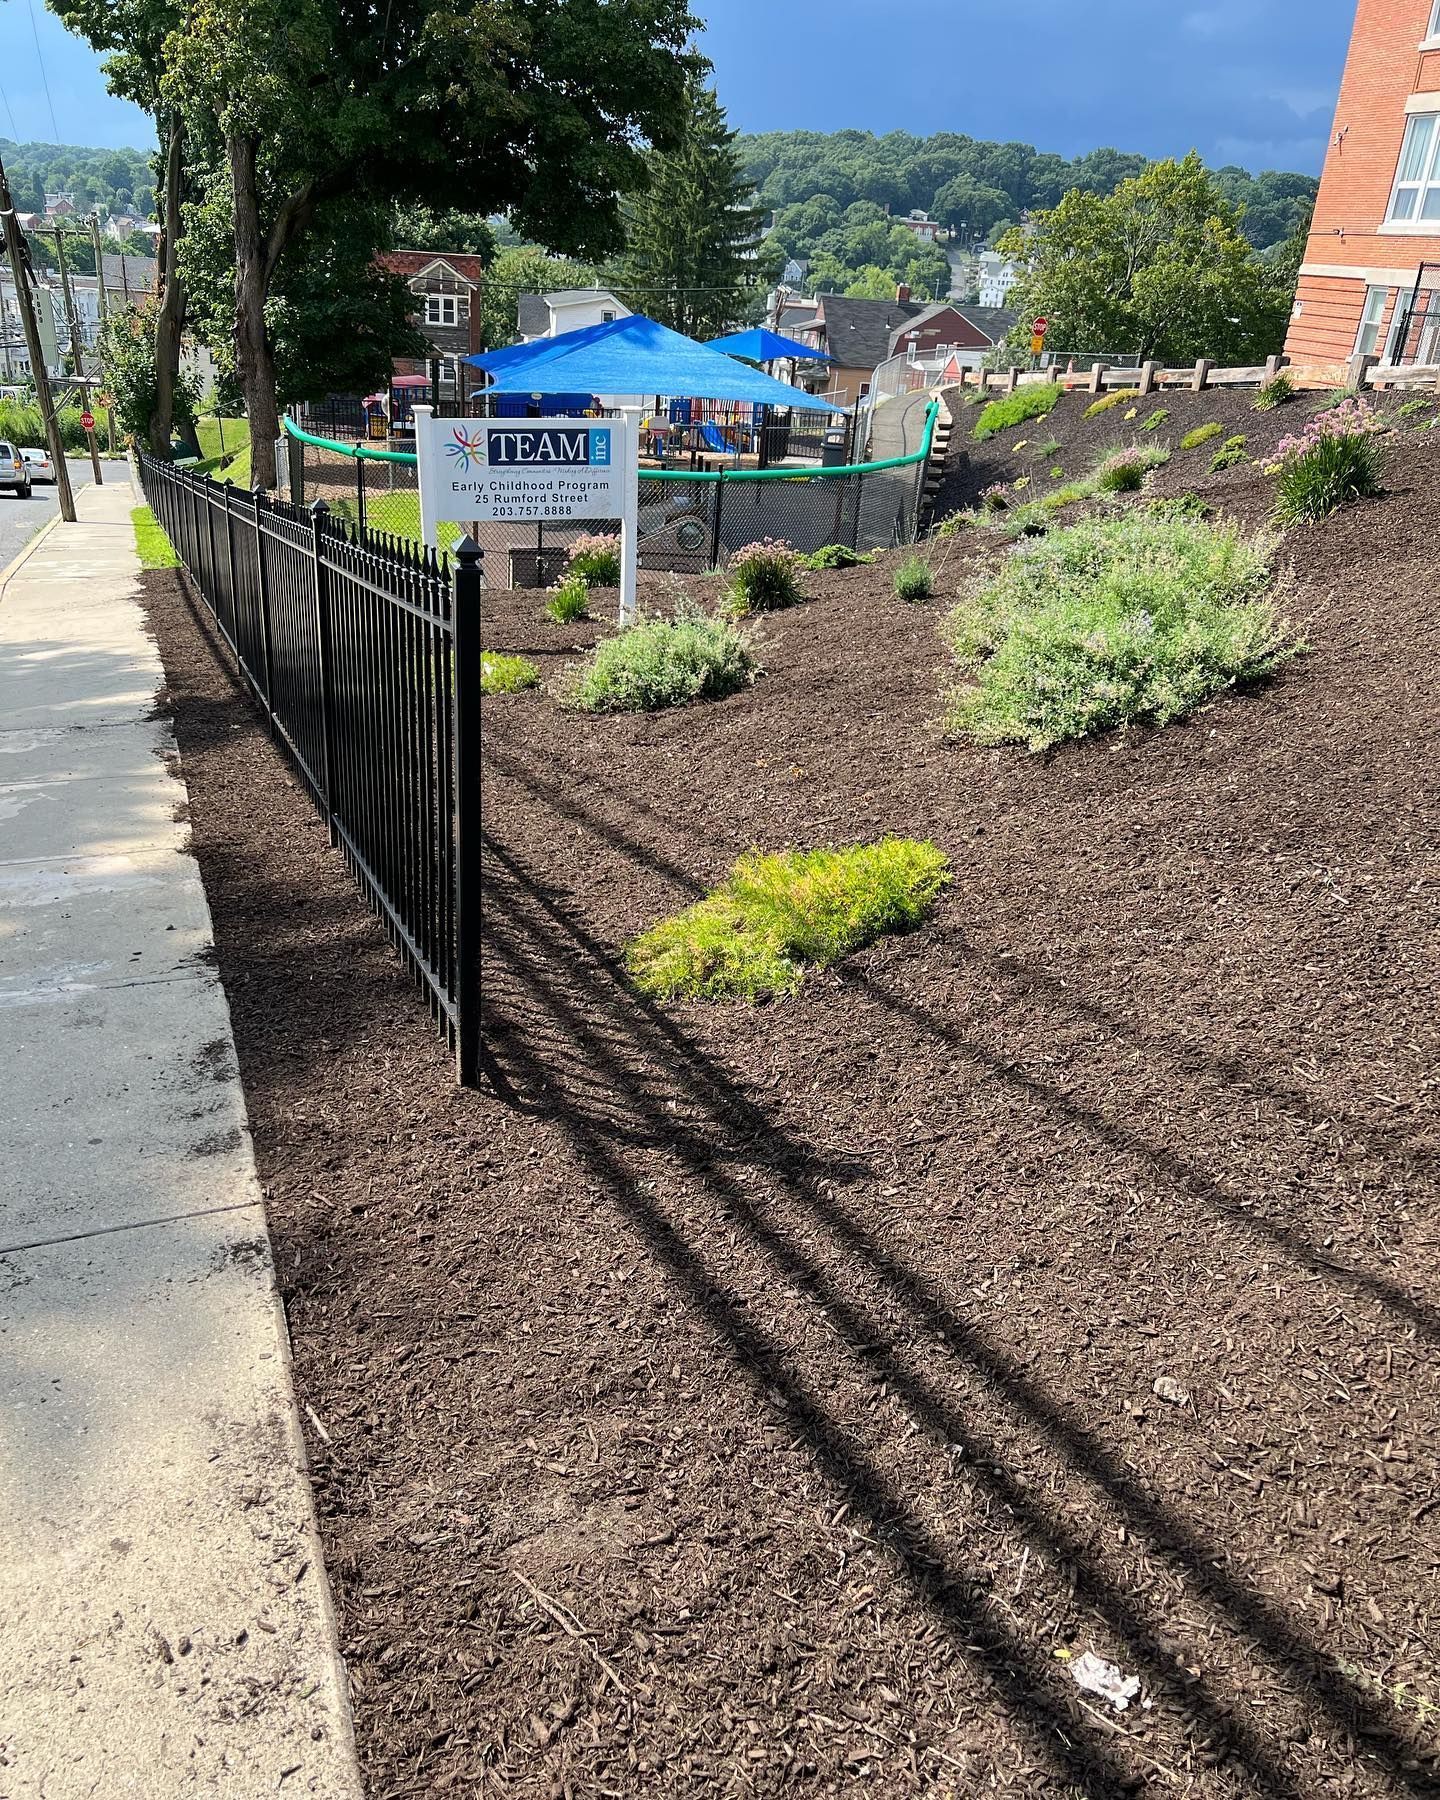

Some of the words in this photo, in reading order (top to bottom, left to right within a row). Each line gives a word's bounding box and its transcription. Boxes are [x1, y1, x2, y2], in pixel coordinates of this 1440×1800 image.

[1034, 323, 1046, 331] STOP
[80, 417, 94, 425] STOP
[490, 432, 587, 461] TEAM
[591, 436, 606, 460] inc
[452, 482, 484, 493] Early
[490, 480, 553, 491] Childhood
[558, 480, 609, 492] Program
[475, 494, 489, 504] 25
[495, 493, 546, 503] Rumford
[552, 493, 588, 503] Street
[492, 506, 572, 516] 203.757.8888
